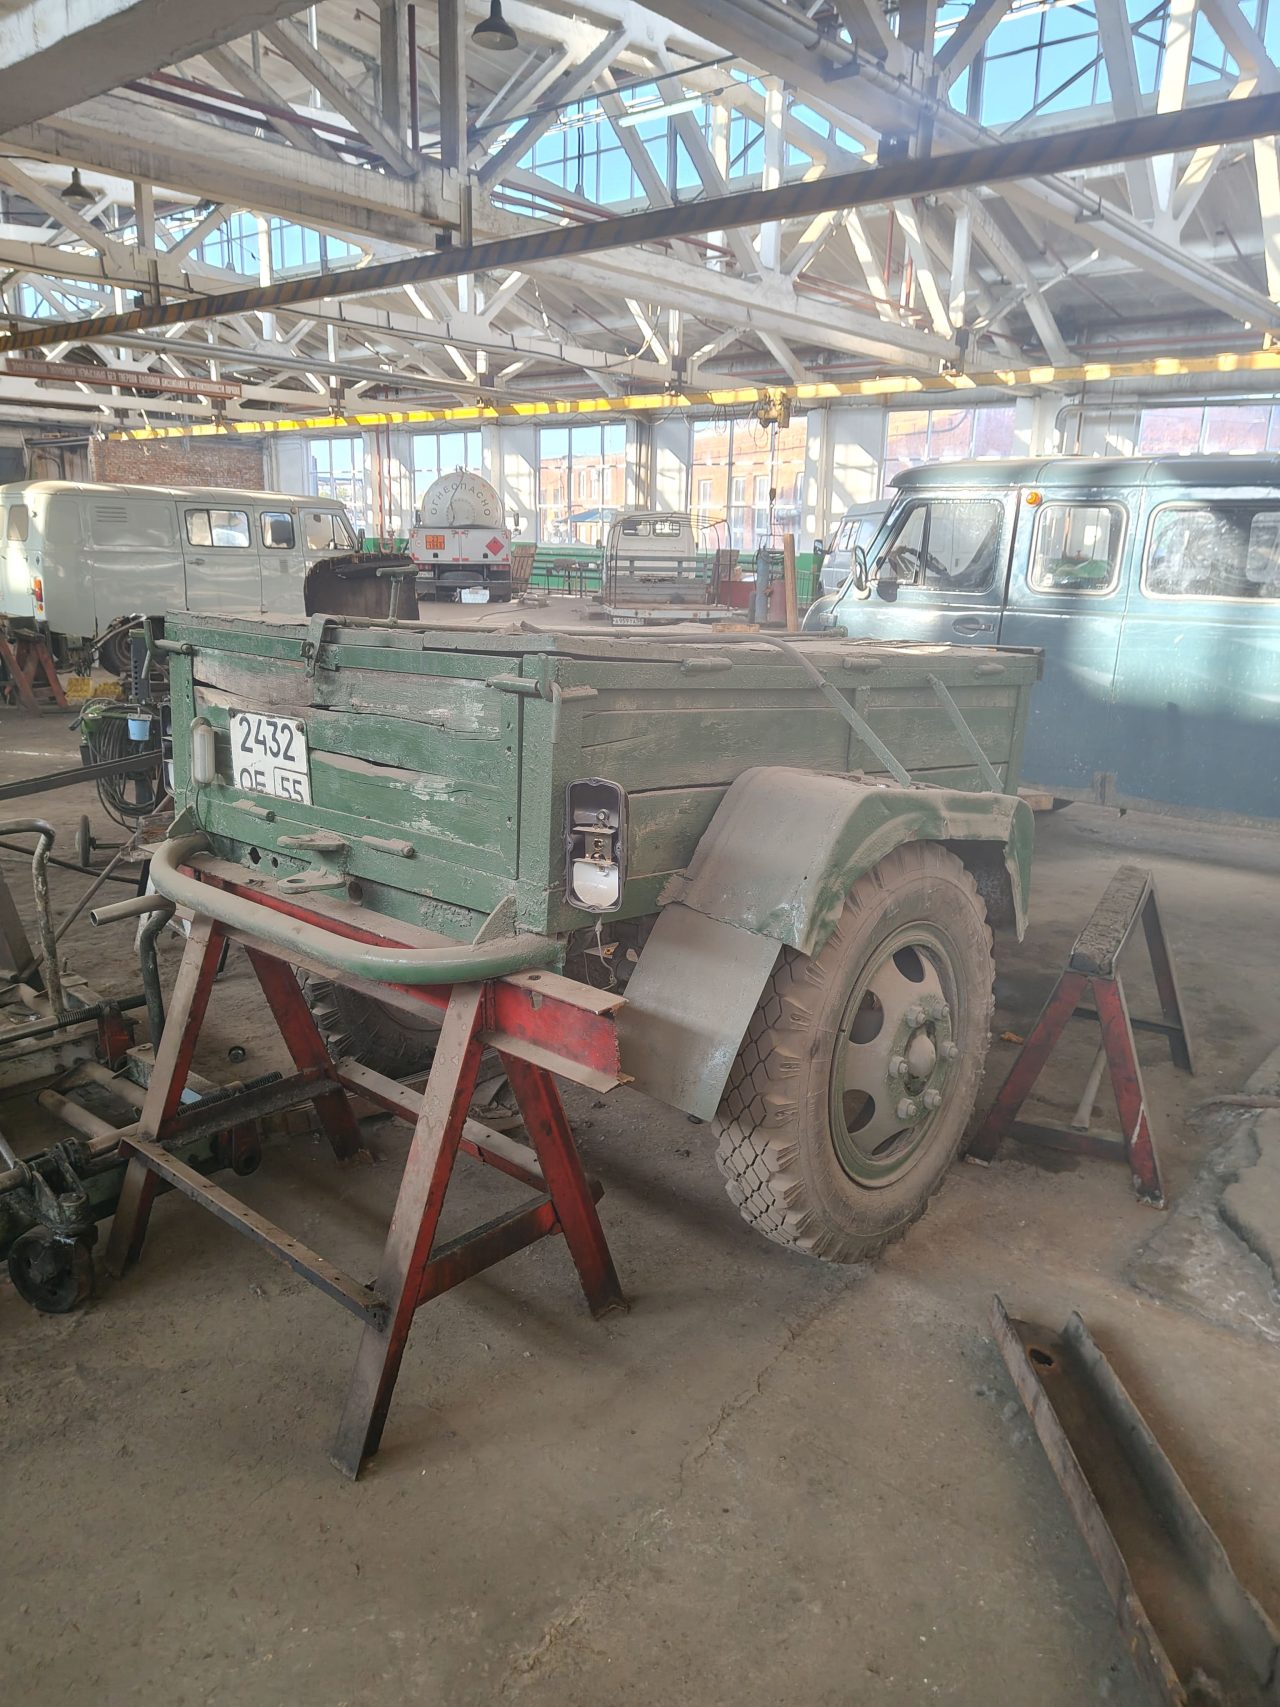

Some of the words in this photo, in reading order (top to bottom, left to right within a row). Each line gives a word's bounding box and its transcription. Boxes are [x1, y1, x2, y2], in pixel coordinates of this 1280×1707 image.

[431, 482, 490, 516] ОГНЕОПАСНО
[239, 716, 295, 762] 2432
[281, 776, 304, 803] 55
